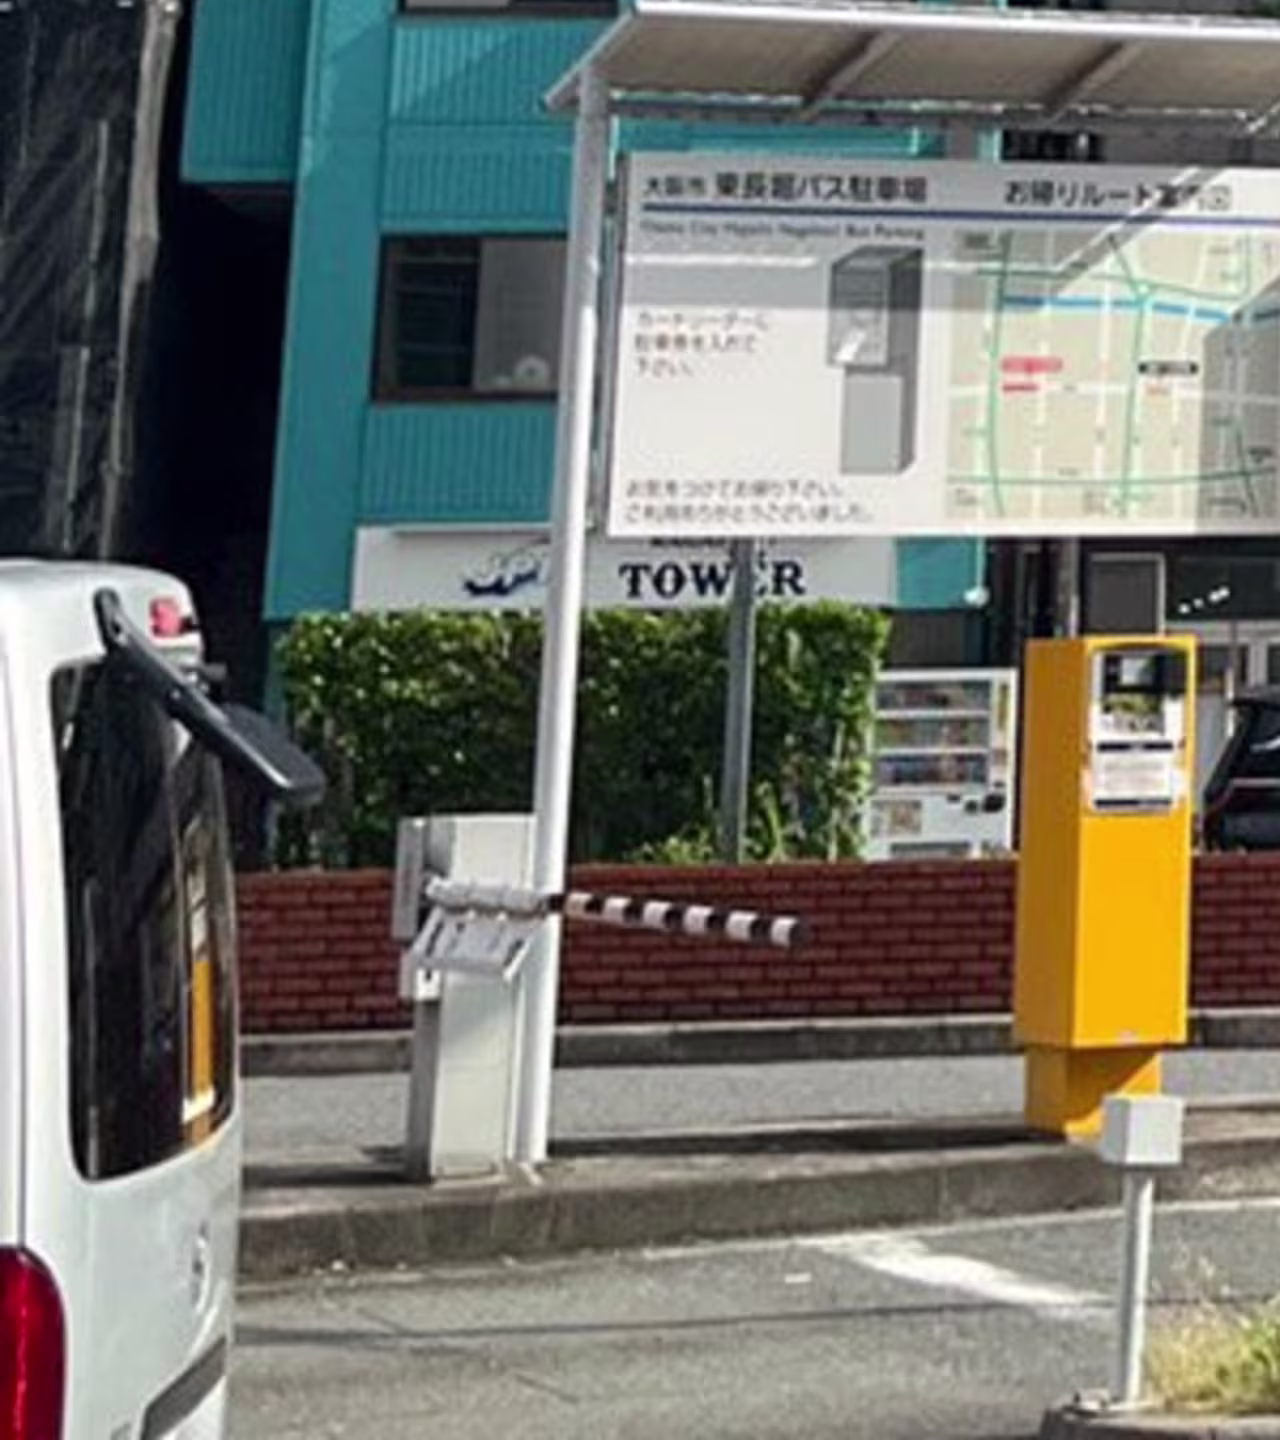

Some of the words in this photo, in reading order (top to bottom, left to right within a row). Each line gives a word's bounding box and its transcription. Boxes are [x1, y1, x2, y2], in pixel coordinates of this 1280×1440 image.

[715, 172, 927, 202] 東長堀バス駐車場
[618, 560, 805, 598] TOWR
